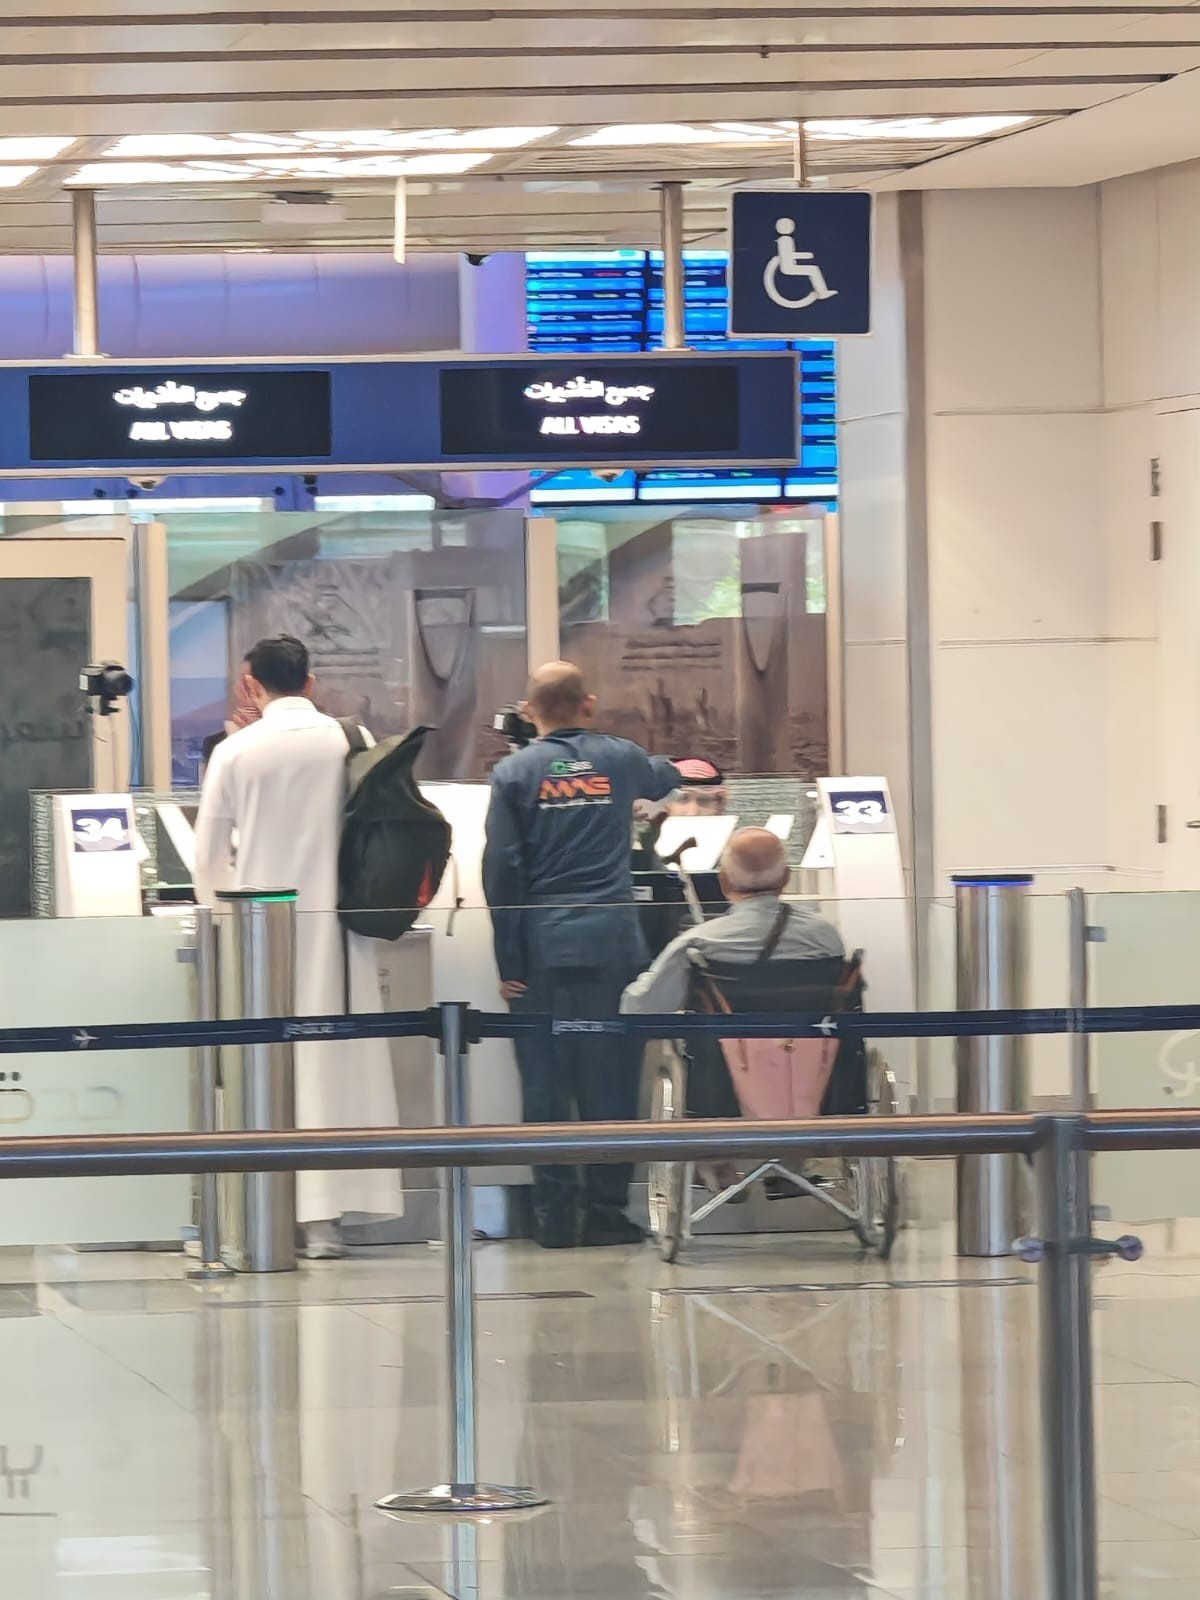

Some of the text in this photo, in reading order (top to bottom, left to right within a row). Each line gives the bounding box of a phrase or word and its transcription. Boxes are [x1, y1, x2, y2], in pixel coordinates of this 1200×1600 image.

[130, 421, 169, 440] ALL
[540, 415, 641, 434] ALL VISAS
[834, 799, 885, 825] 33
[75, 817, 130, 842] 34
